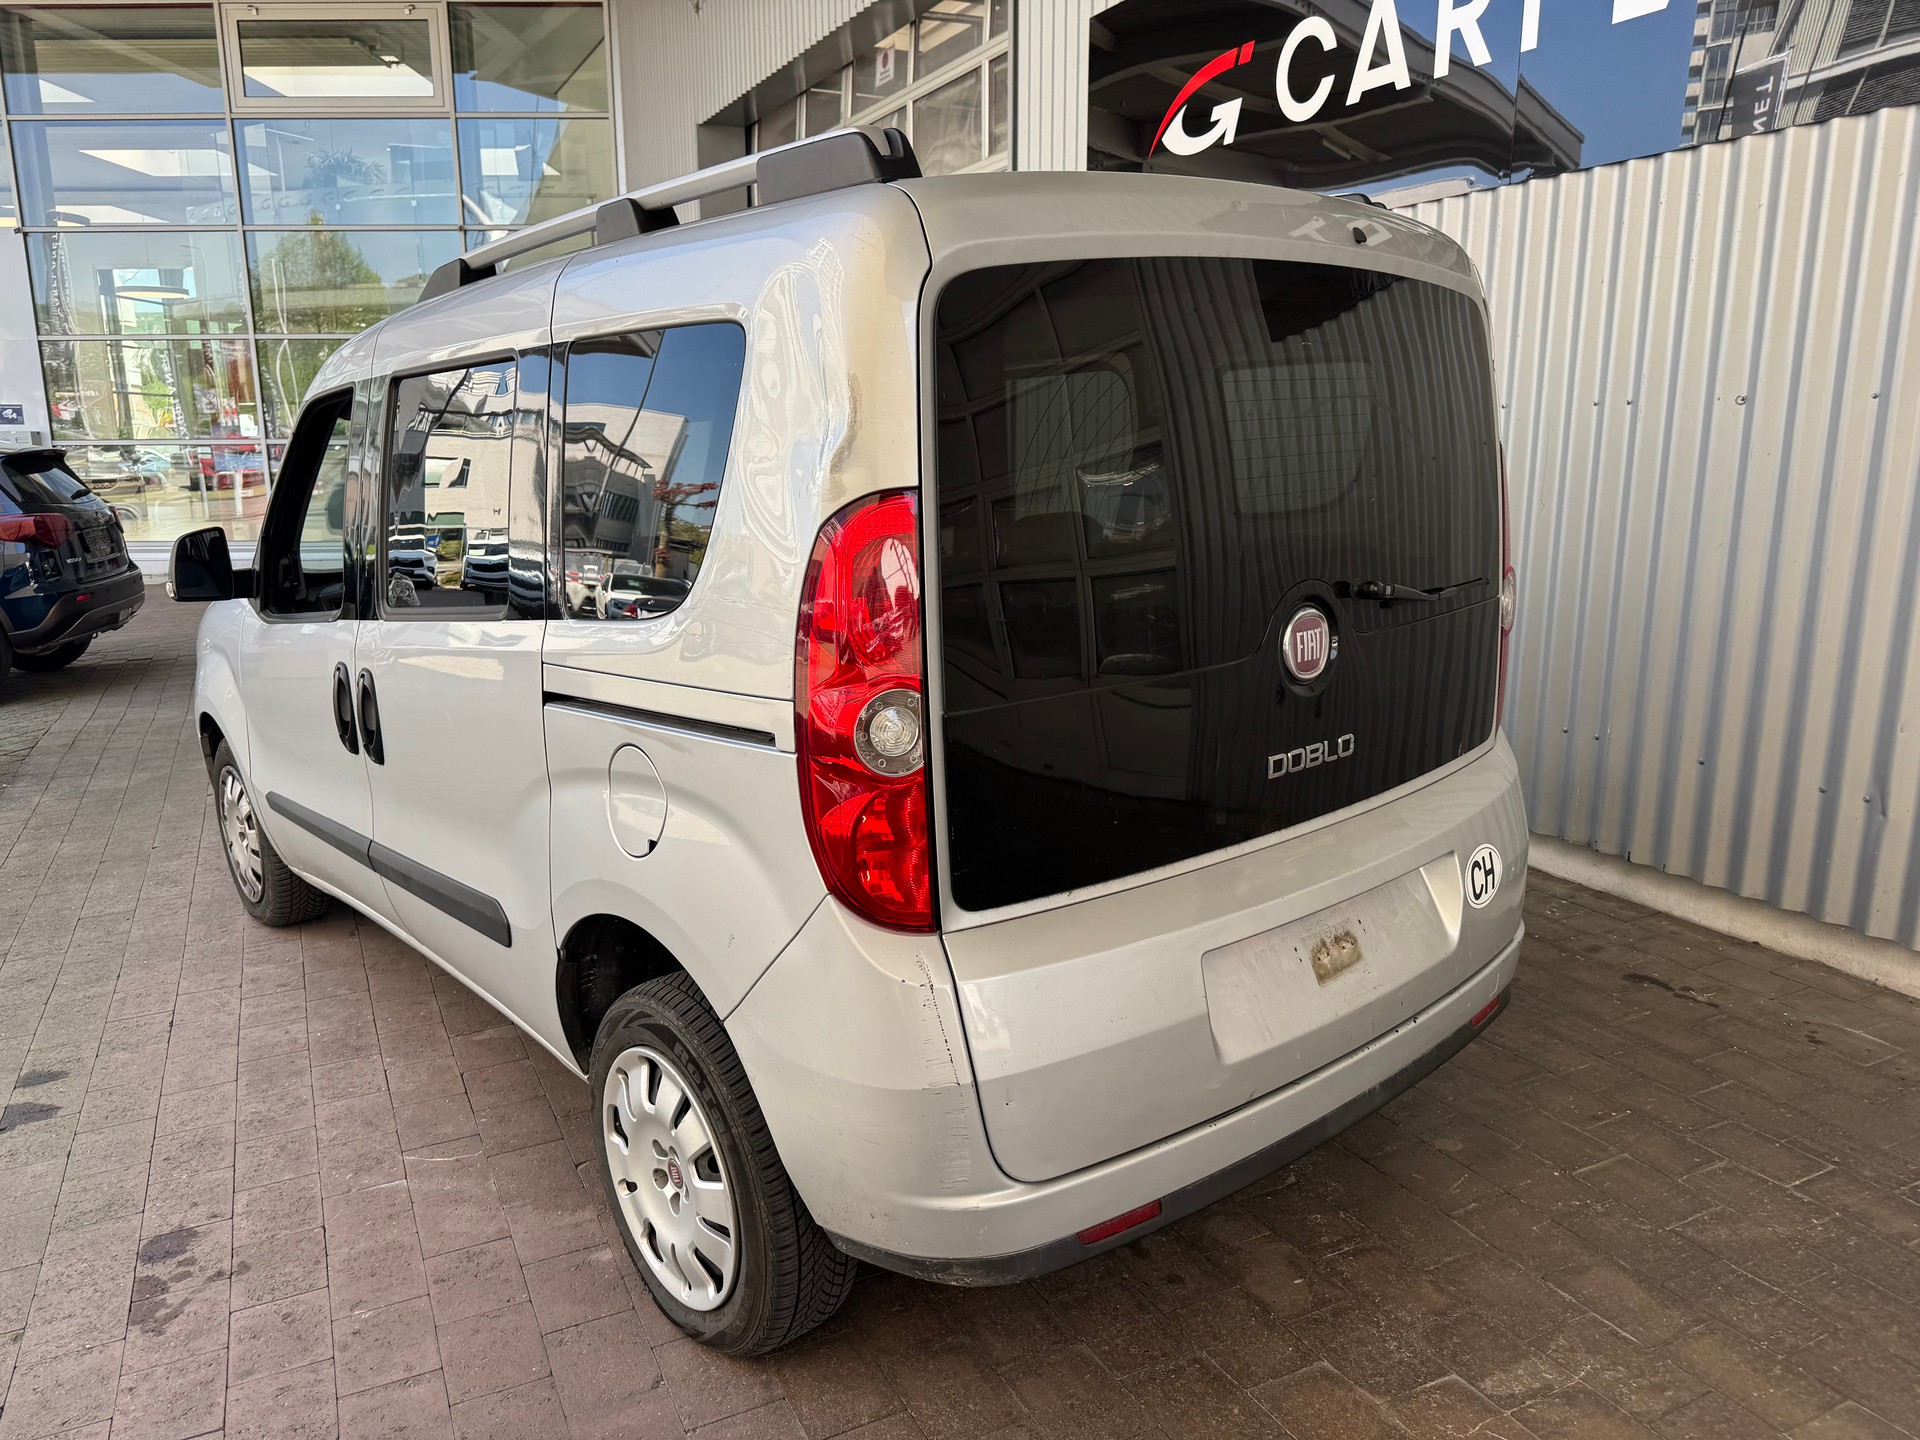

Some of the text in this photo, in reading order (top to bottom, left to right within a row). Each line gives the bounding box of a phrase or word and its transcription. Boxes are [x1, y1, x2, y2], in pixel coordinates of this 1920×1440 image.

[1296, 628, 1322, 663] FIAT
[1267, 733, 1355, 780] DOBLO
[1471, 851, 1495, 901] CH
[670, 1165, 681, 1184] FIAT
